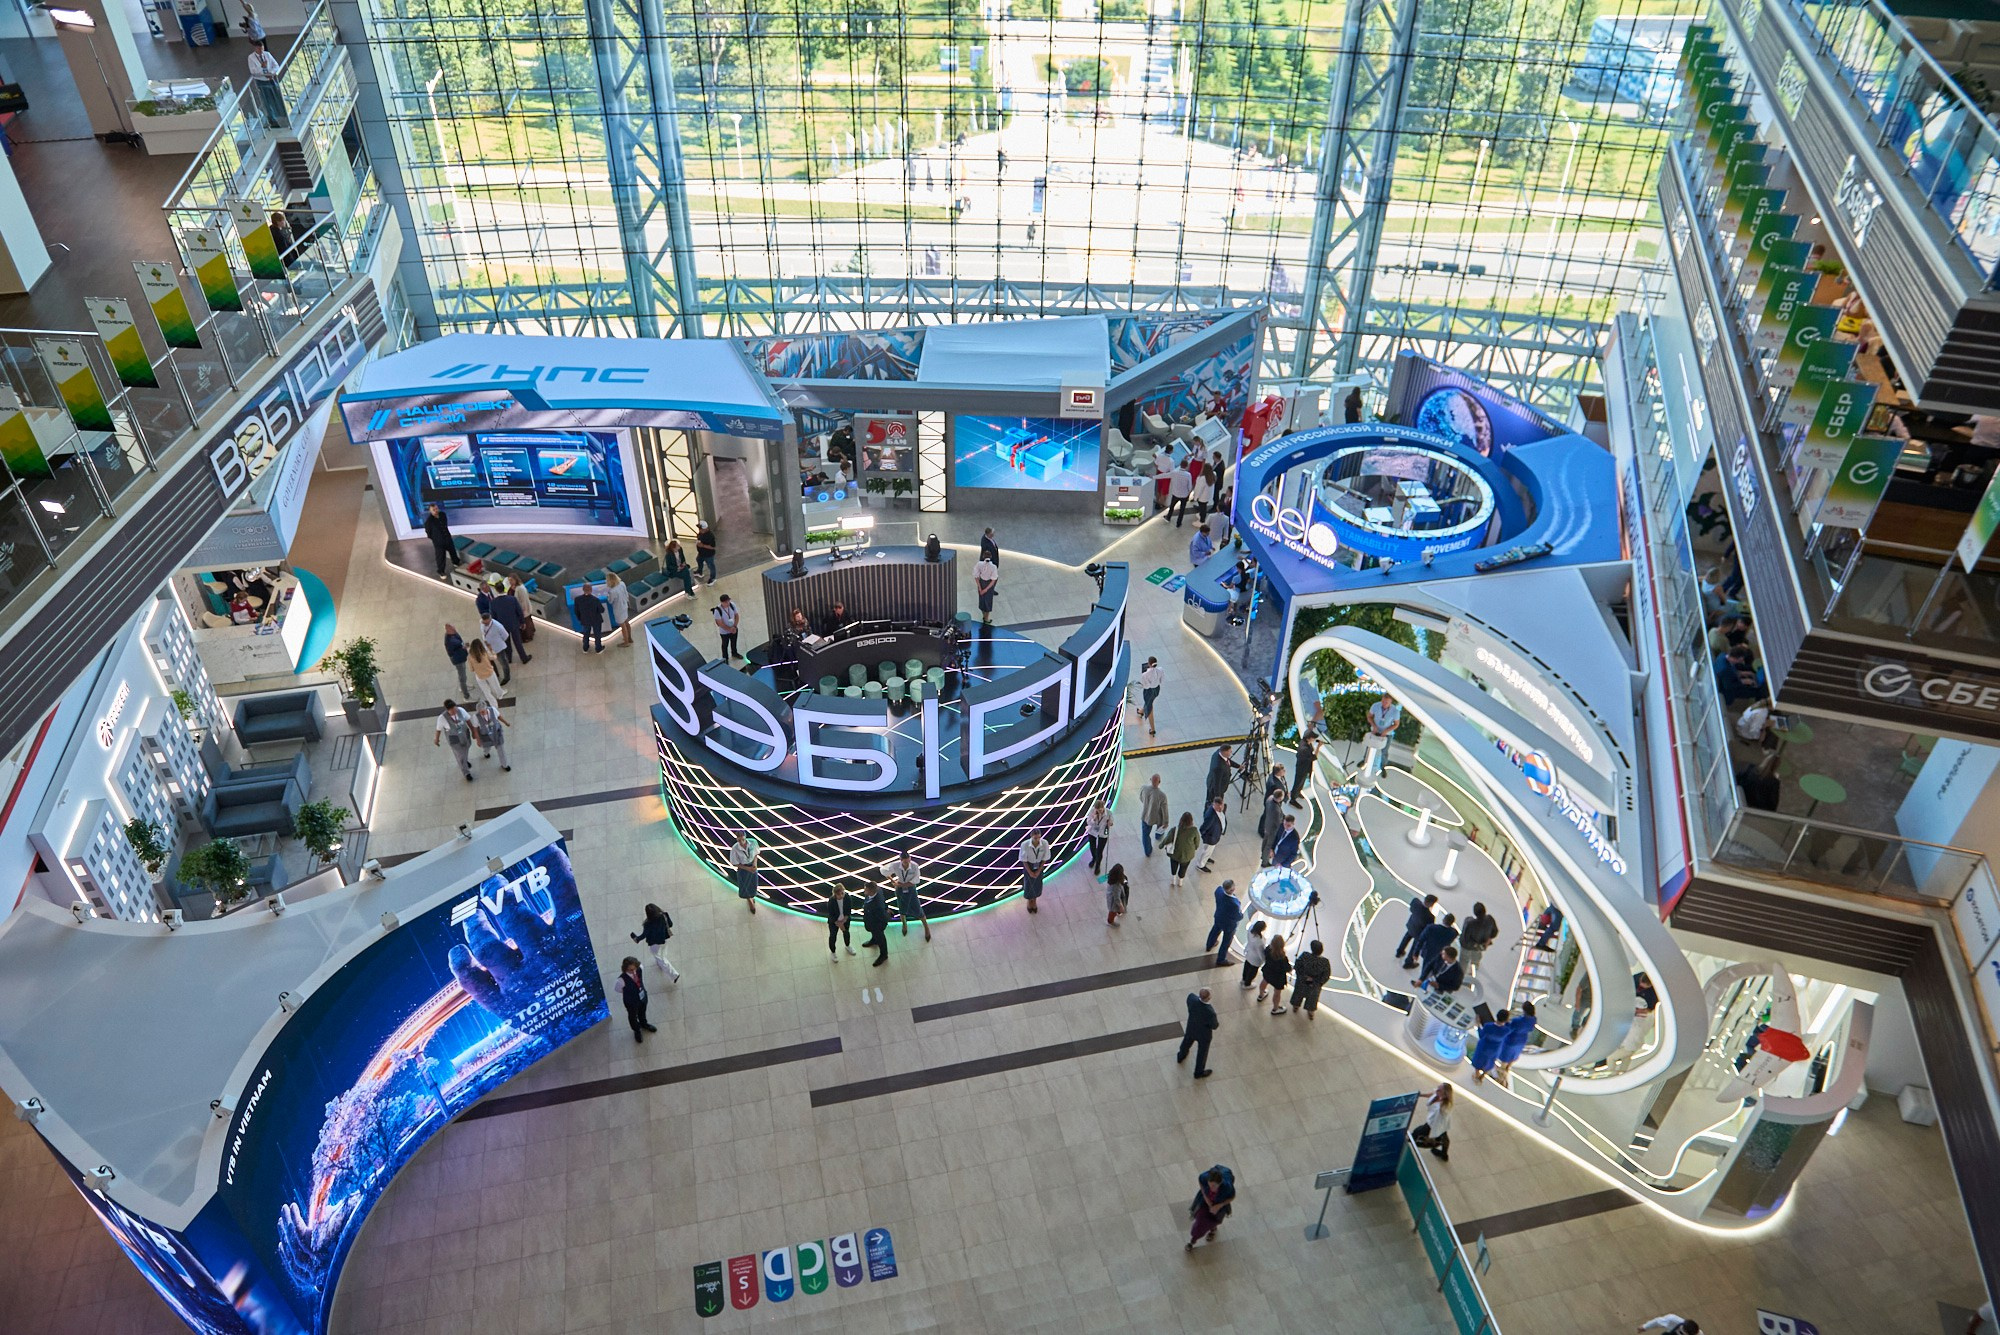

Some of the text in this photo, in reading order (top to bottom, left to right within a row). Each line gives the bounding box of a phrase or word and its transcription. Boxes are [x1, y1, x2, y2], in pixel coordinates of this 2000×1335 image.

[1776, 281, 1802, 327] SBER
[490, 364, 651, 385] НПС
[396, 399, 515, 418] НАЦПРОЕКТ
[399, 413, 467, 428] СТРОЙ
[1824, 393, 1855, 439] СБЕР
[1250, 424, 1455, 468] ФЛАГМАН РОССИЙСКОЙ ЛОГИСТИКИ
[1736, 464, 1756, 520] SBER
[1249, 520, 1335, 570] ГРУППА КОМПАНИЙ
[480, 866, 551, 915] VTB
[516, 1002, 542, 1023] TO
[545, 976, 584, 1006] 50%
[534, 965, 582, 999] SERVICING
[528, 994, 588, 1035] AND VIETNAM
[540, 987, 587, 1019] TURNOVER
[226, 1068, 273, 1186] VTB IN VIETNAM
[763, 1246, 793, 1282] D
[798, 1241, 825, 1277] C
[831, 1232, 860, 1268] B
[738, 1275, 750, 1291] S
